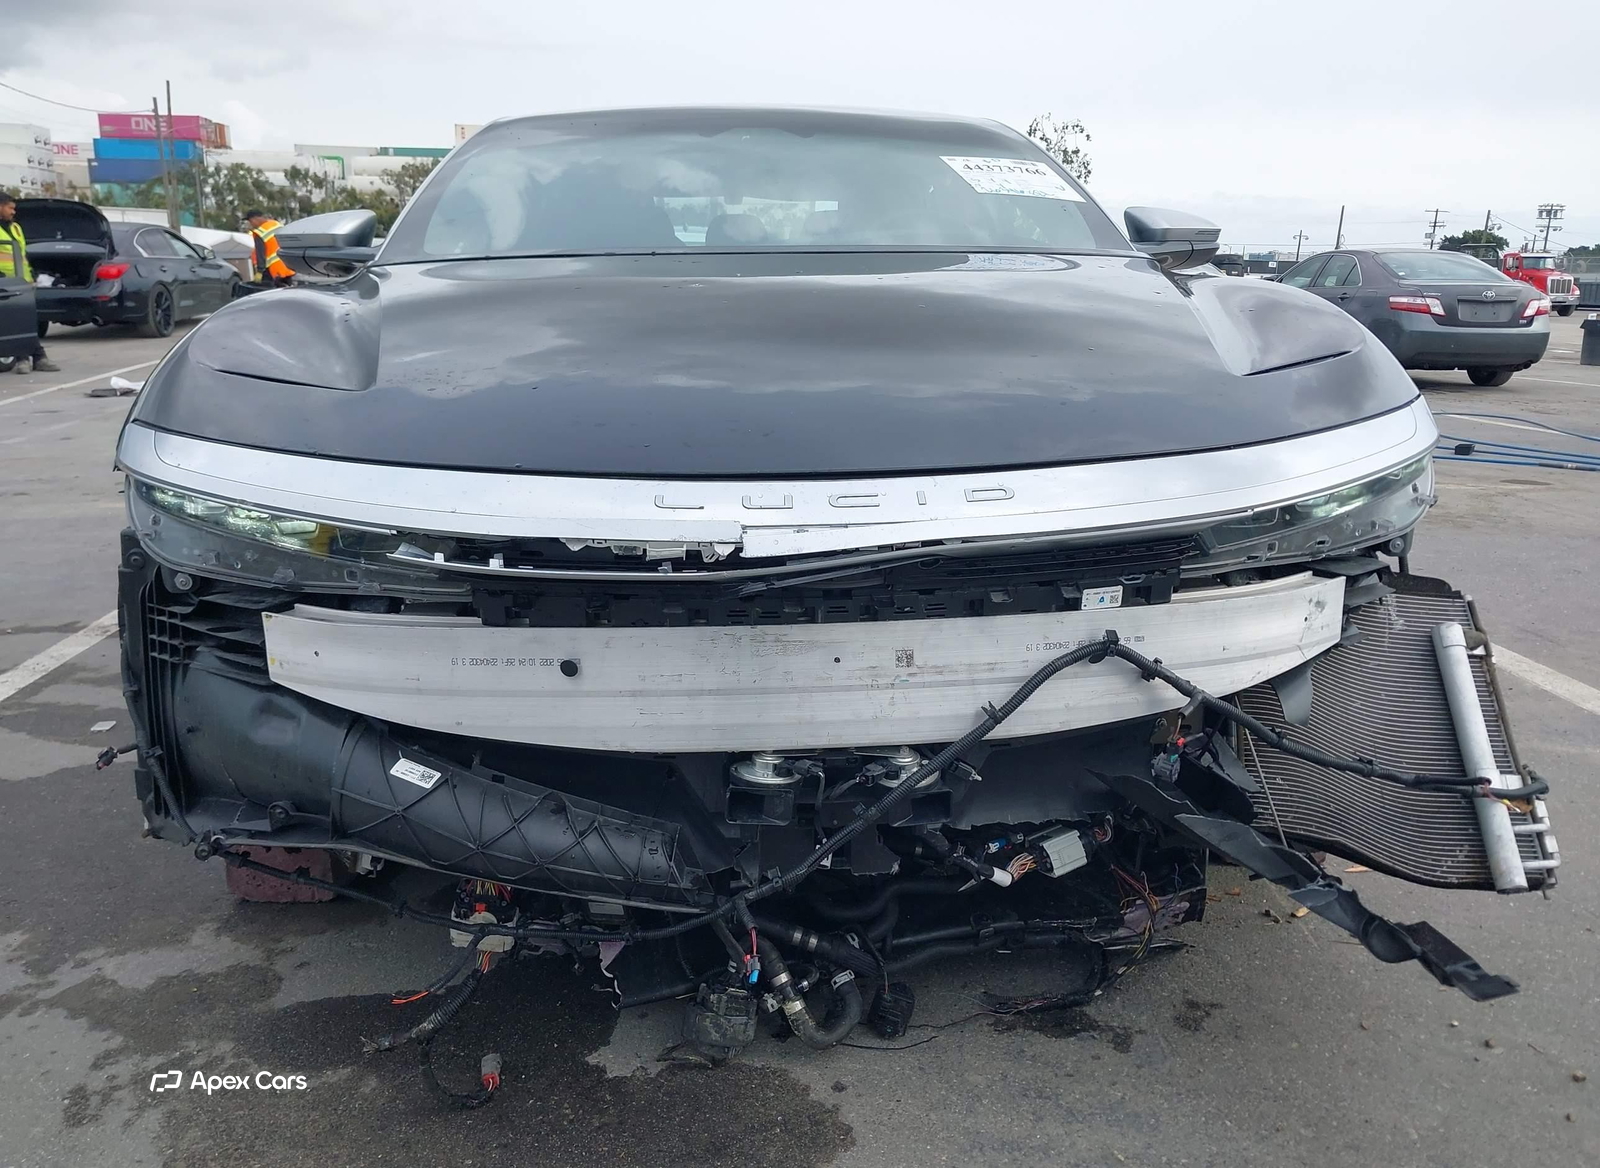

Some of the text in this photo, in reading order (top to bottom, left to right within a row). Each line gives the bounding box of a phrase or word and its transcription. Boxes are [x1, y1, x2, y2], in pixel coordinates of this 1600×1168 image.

[131, 117, 167, 131] ONE
[962, 163, 1047, 176] 44373766
[653, 483, 1015, 510] LUCID
[1025, 643, 1033, 651] 19
[451, 658, 459, 666] 19
[461, 658, 466, 666] 3
[539, 658, 555, 667] 2022
